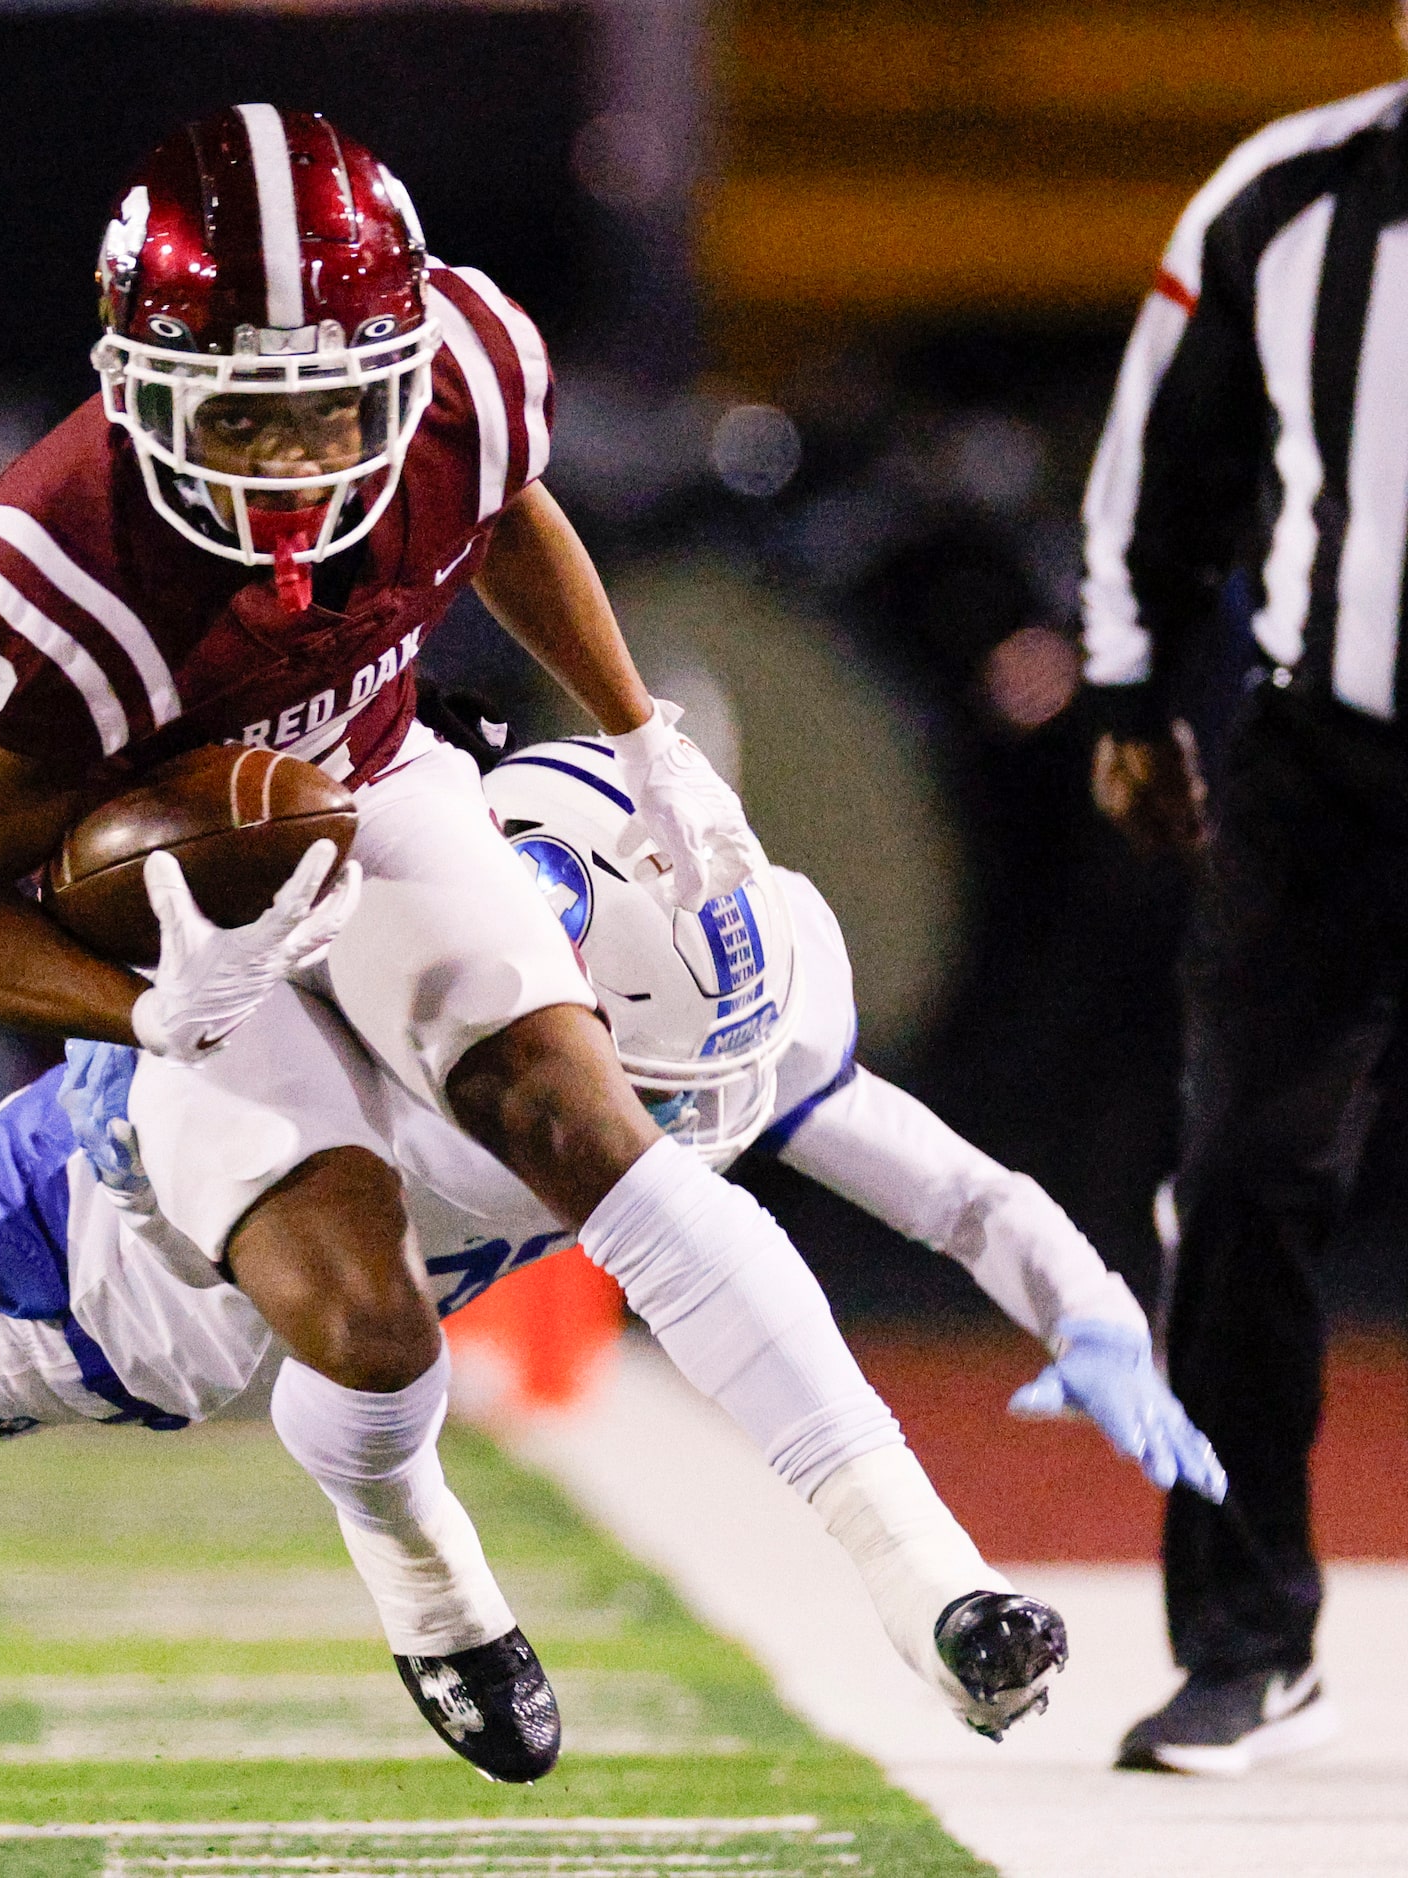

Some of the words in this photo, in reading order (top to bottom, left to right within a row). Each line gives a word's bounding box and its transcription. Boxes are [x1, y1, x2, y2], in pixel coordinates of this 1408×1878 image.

[242, 688, 336, 749] RED
[348, 622, 425, 708] OAK
[715, 907, 741, 930] WIN
[722, 927, 747, 948] WIN
[727, 945, 752, 967] WIN
[731, 963, 754, 985] WIN
[730, 990, 754, 1011] WIN
